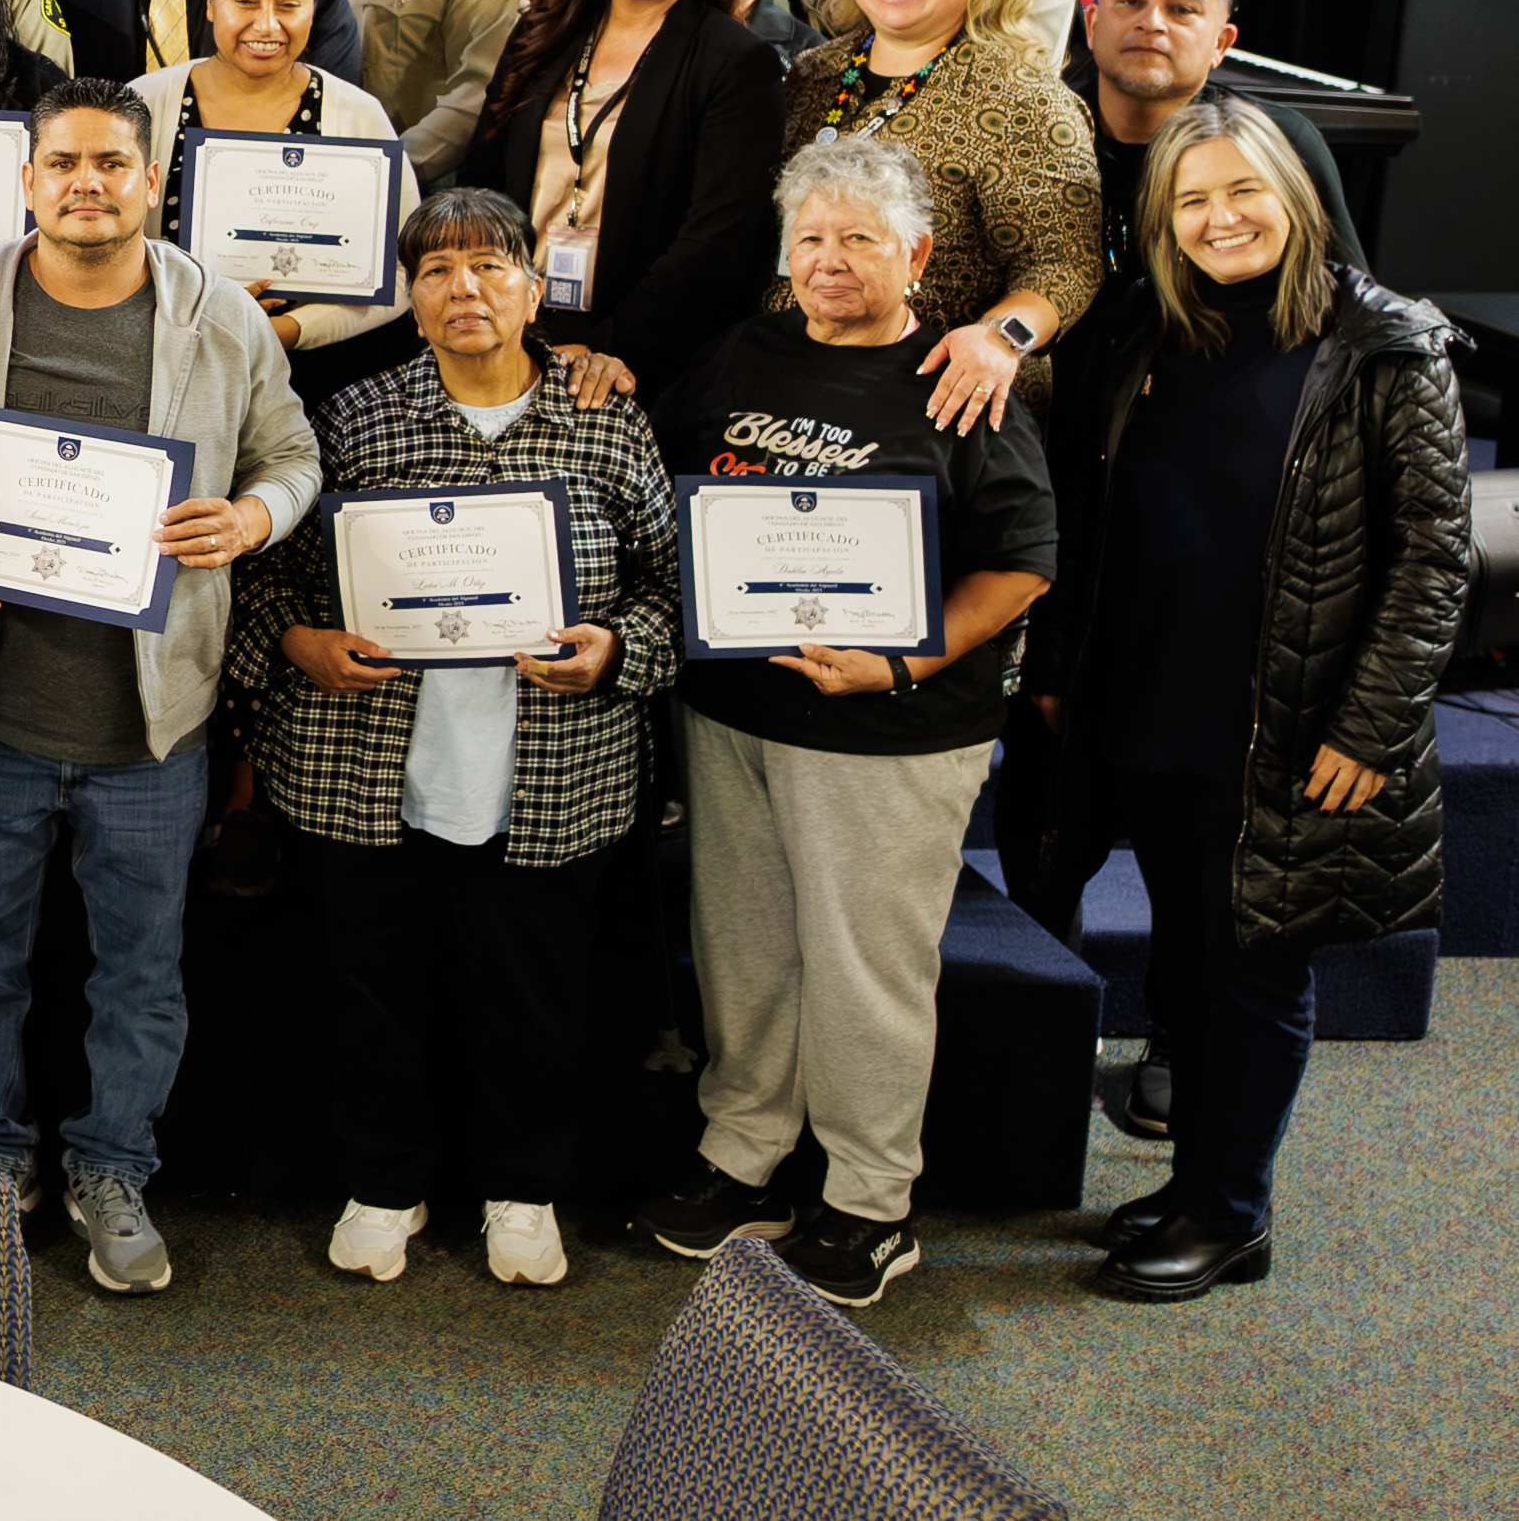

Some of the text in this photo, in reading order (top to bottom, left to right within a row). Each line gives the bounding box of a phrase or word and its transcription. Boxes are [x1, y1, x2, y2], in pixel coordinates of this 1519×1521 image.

[249, 185, 335, 201] CERTIFICADO
[724, 412, 880, 470] Blessed
[790, 417, 853, 445] I'M TOO
[774, 459, 799, 476] TO
[804, 462, 831, 477] BE
[18, 477, 110, 503] CERTIFICADO
[757, 531, 859, 547] CERTIFICADO
[399, 544, 497, 560] CERTIFICADO
[870, 1232, 901, 1269] HOKA
